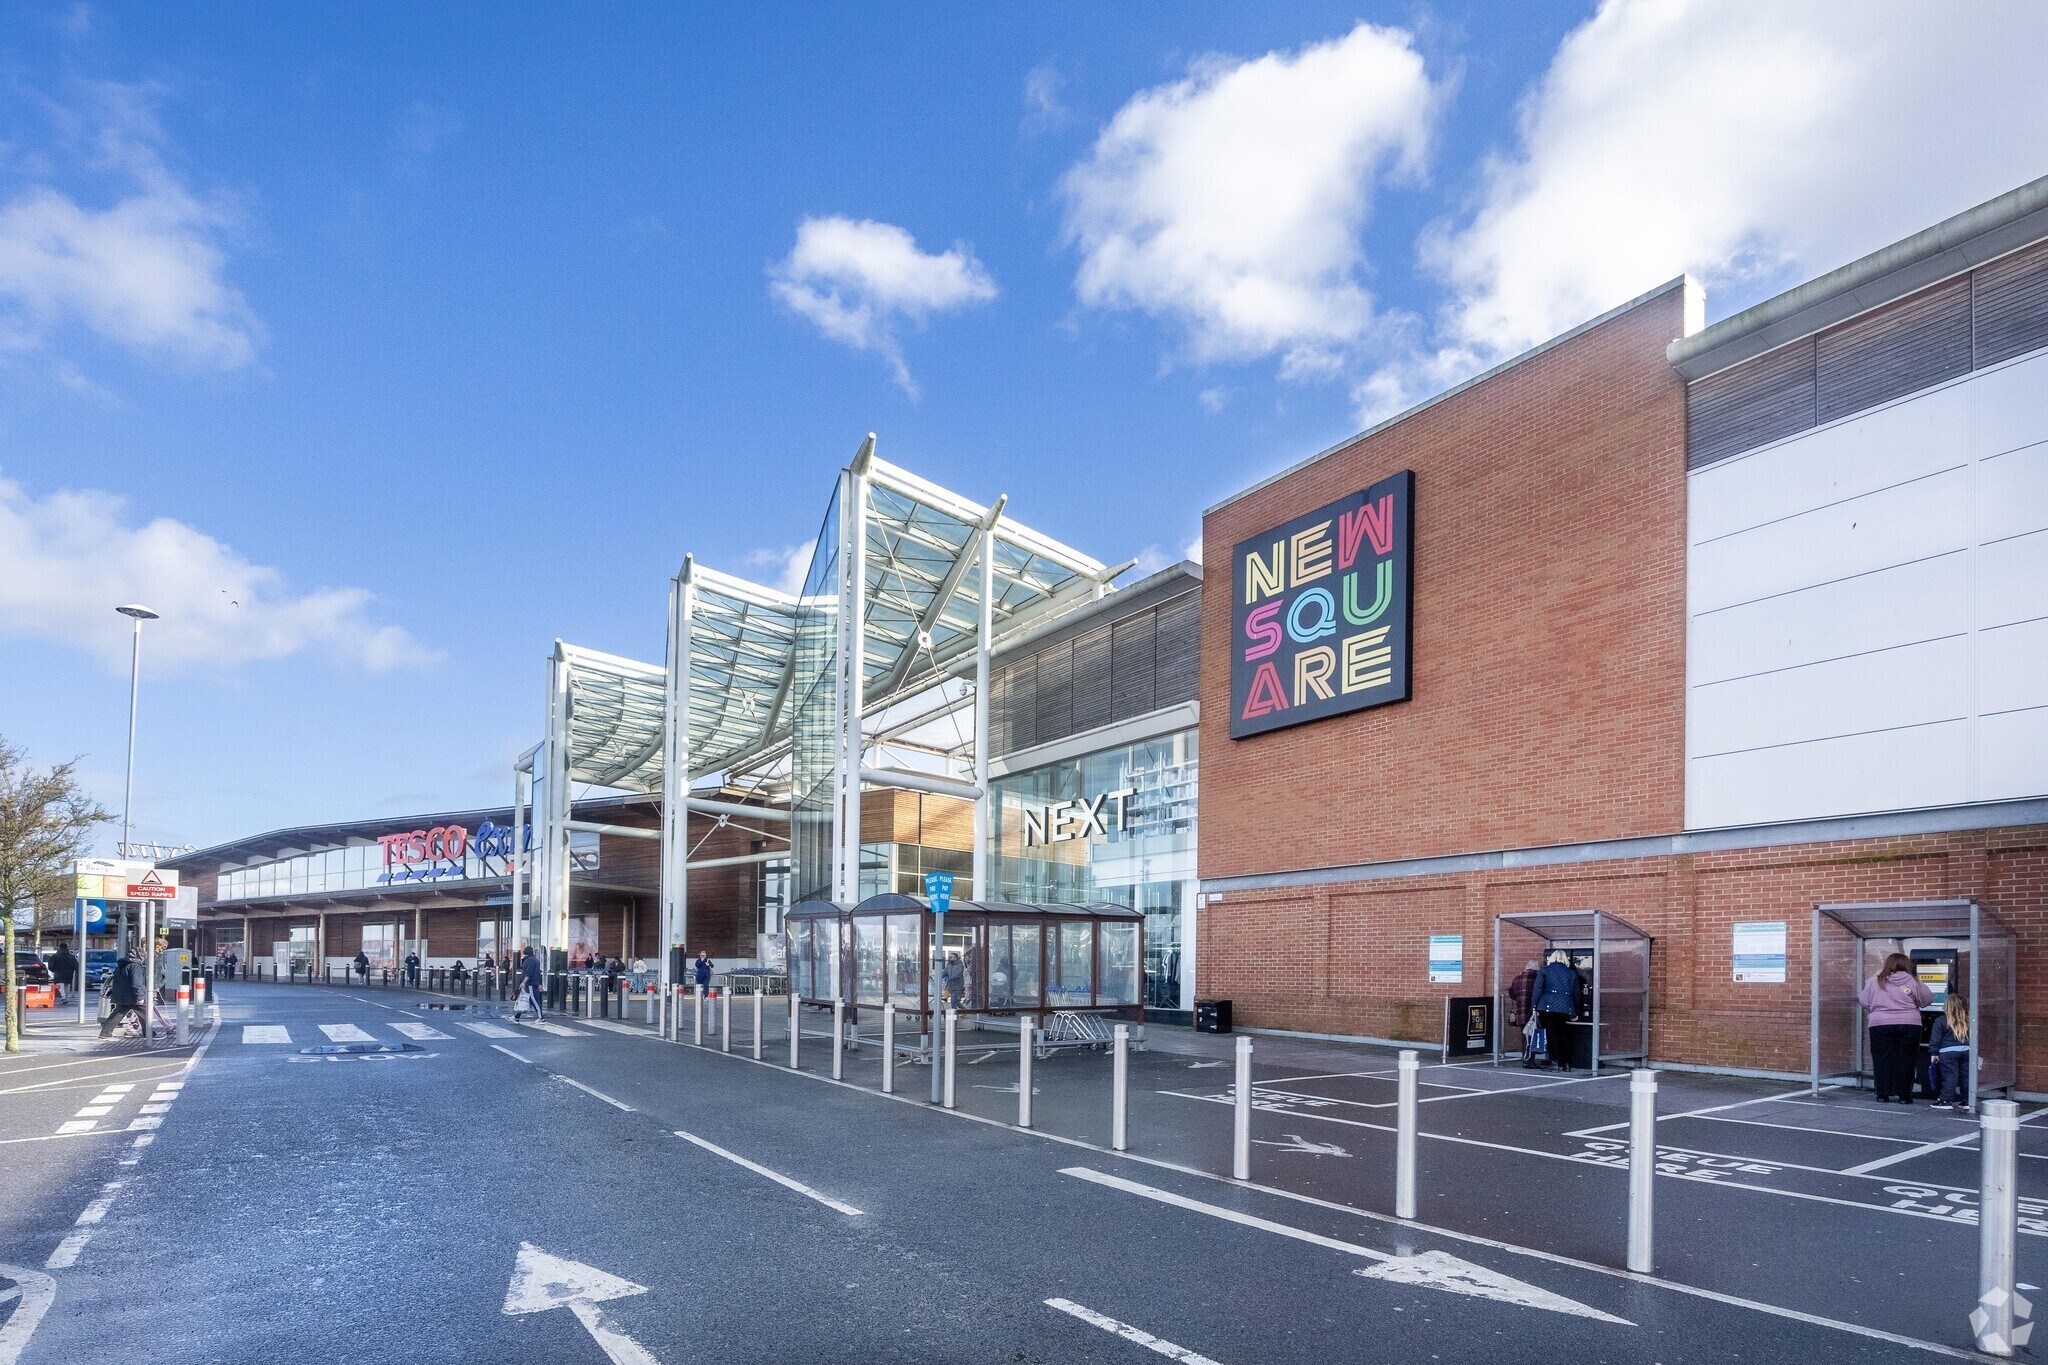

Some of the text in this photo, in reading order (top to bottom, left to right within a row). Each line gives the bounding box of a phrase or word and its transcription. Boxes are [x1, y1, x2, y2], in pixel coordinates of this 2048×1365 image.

[1245, 493, 1393, 605] NEW
[1245, 559, 1393, 662] SQU
[1241, 624, 1392, 720] ARE
[1024, 787, 1139, 847] NEXT
[377, 824, 467, 866] TESCO
[925, 876, 938, 884] PLEASE
[939, 876, 952, 884] PLEASE
[769, 946, 787, 959] Caf
[287, 1053, 441, 1063] SLOW
